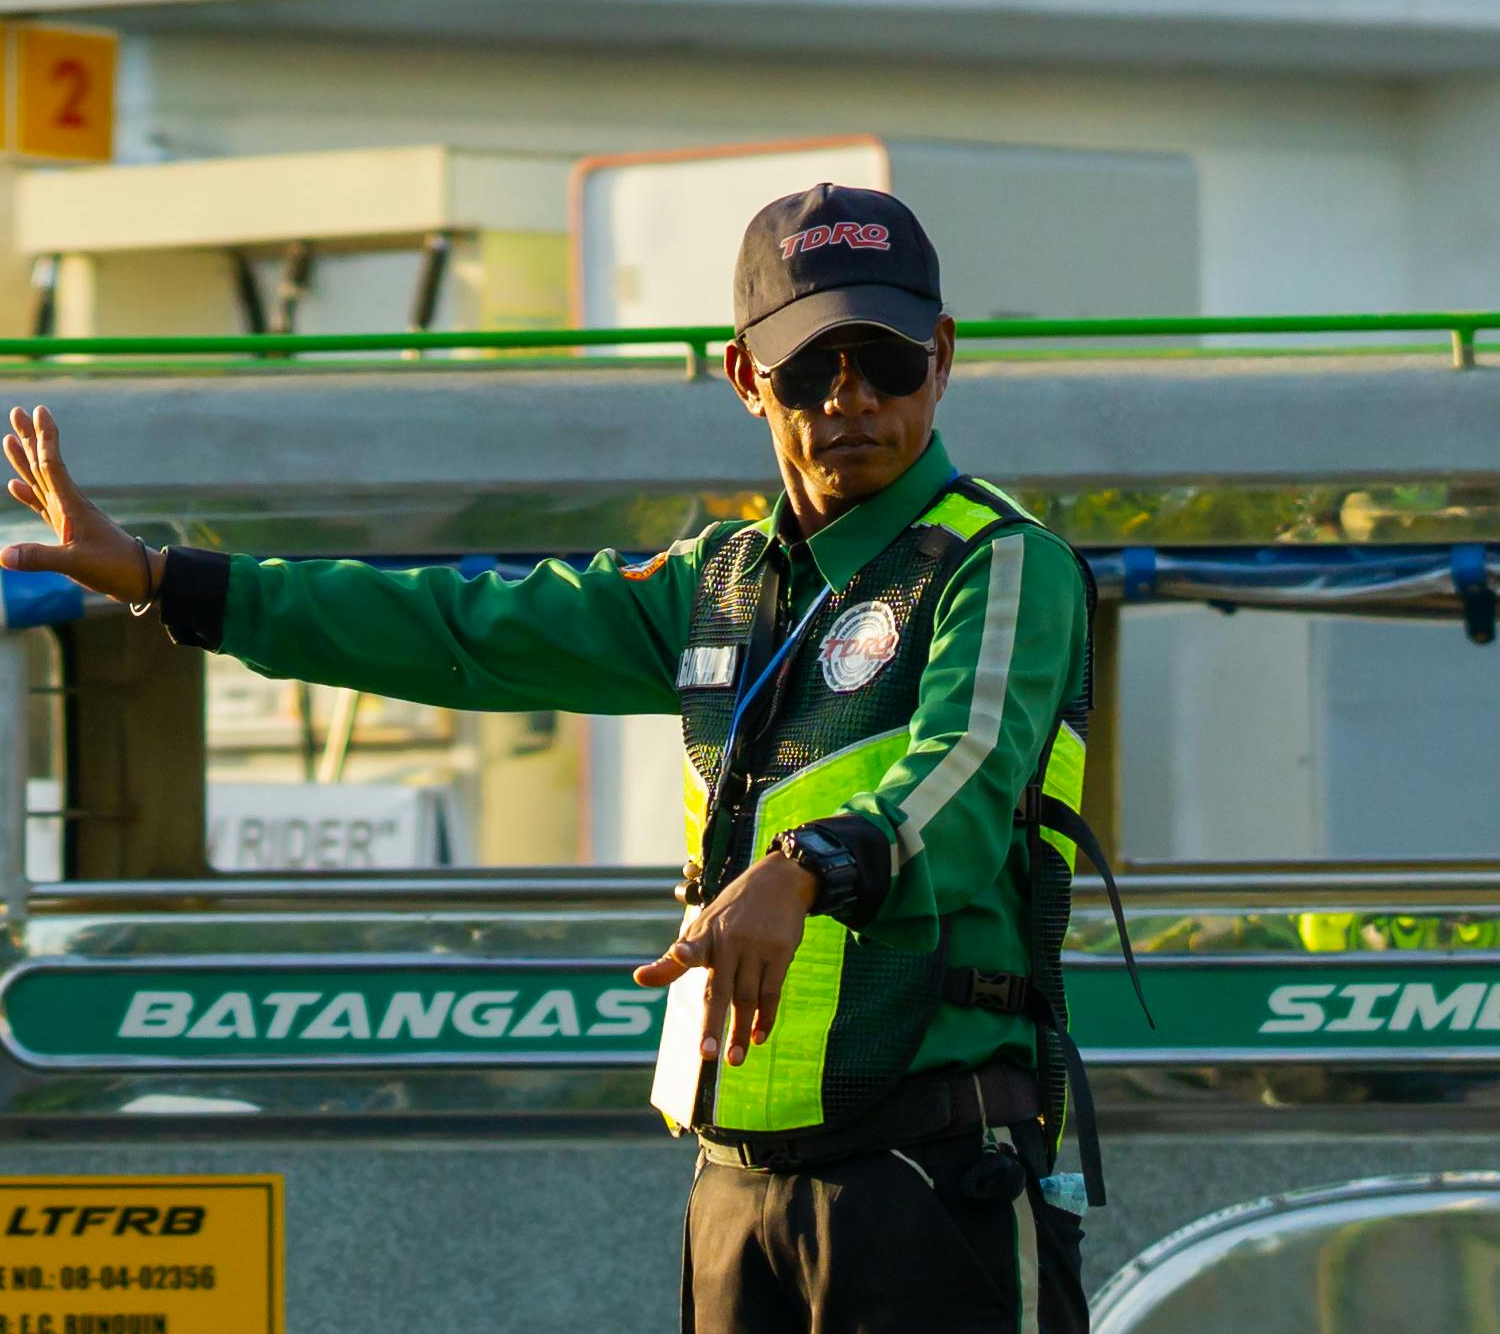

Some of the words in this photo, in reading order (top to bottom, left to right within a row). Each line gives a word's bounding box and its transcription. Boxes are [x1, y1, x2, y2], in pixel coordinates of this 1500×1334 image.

[51, 59, 89, 128] 2
[118, 989, 668, 1040] BATANGAS
[5, 1205, 206, 1237] LTFRB
